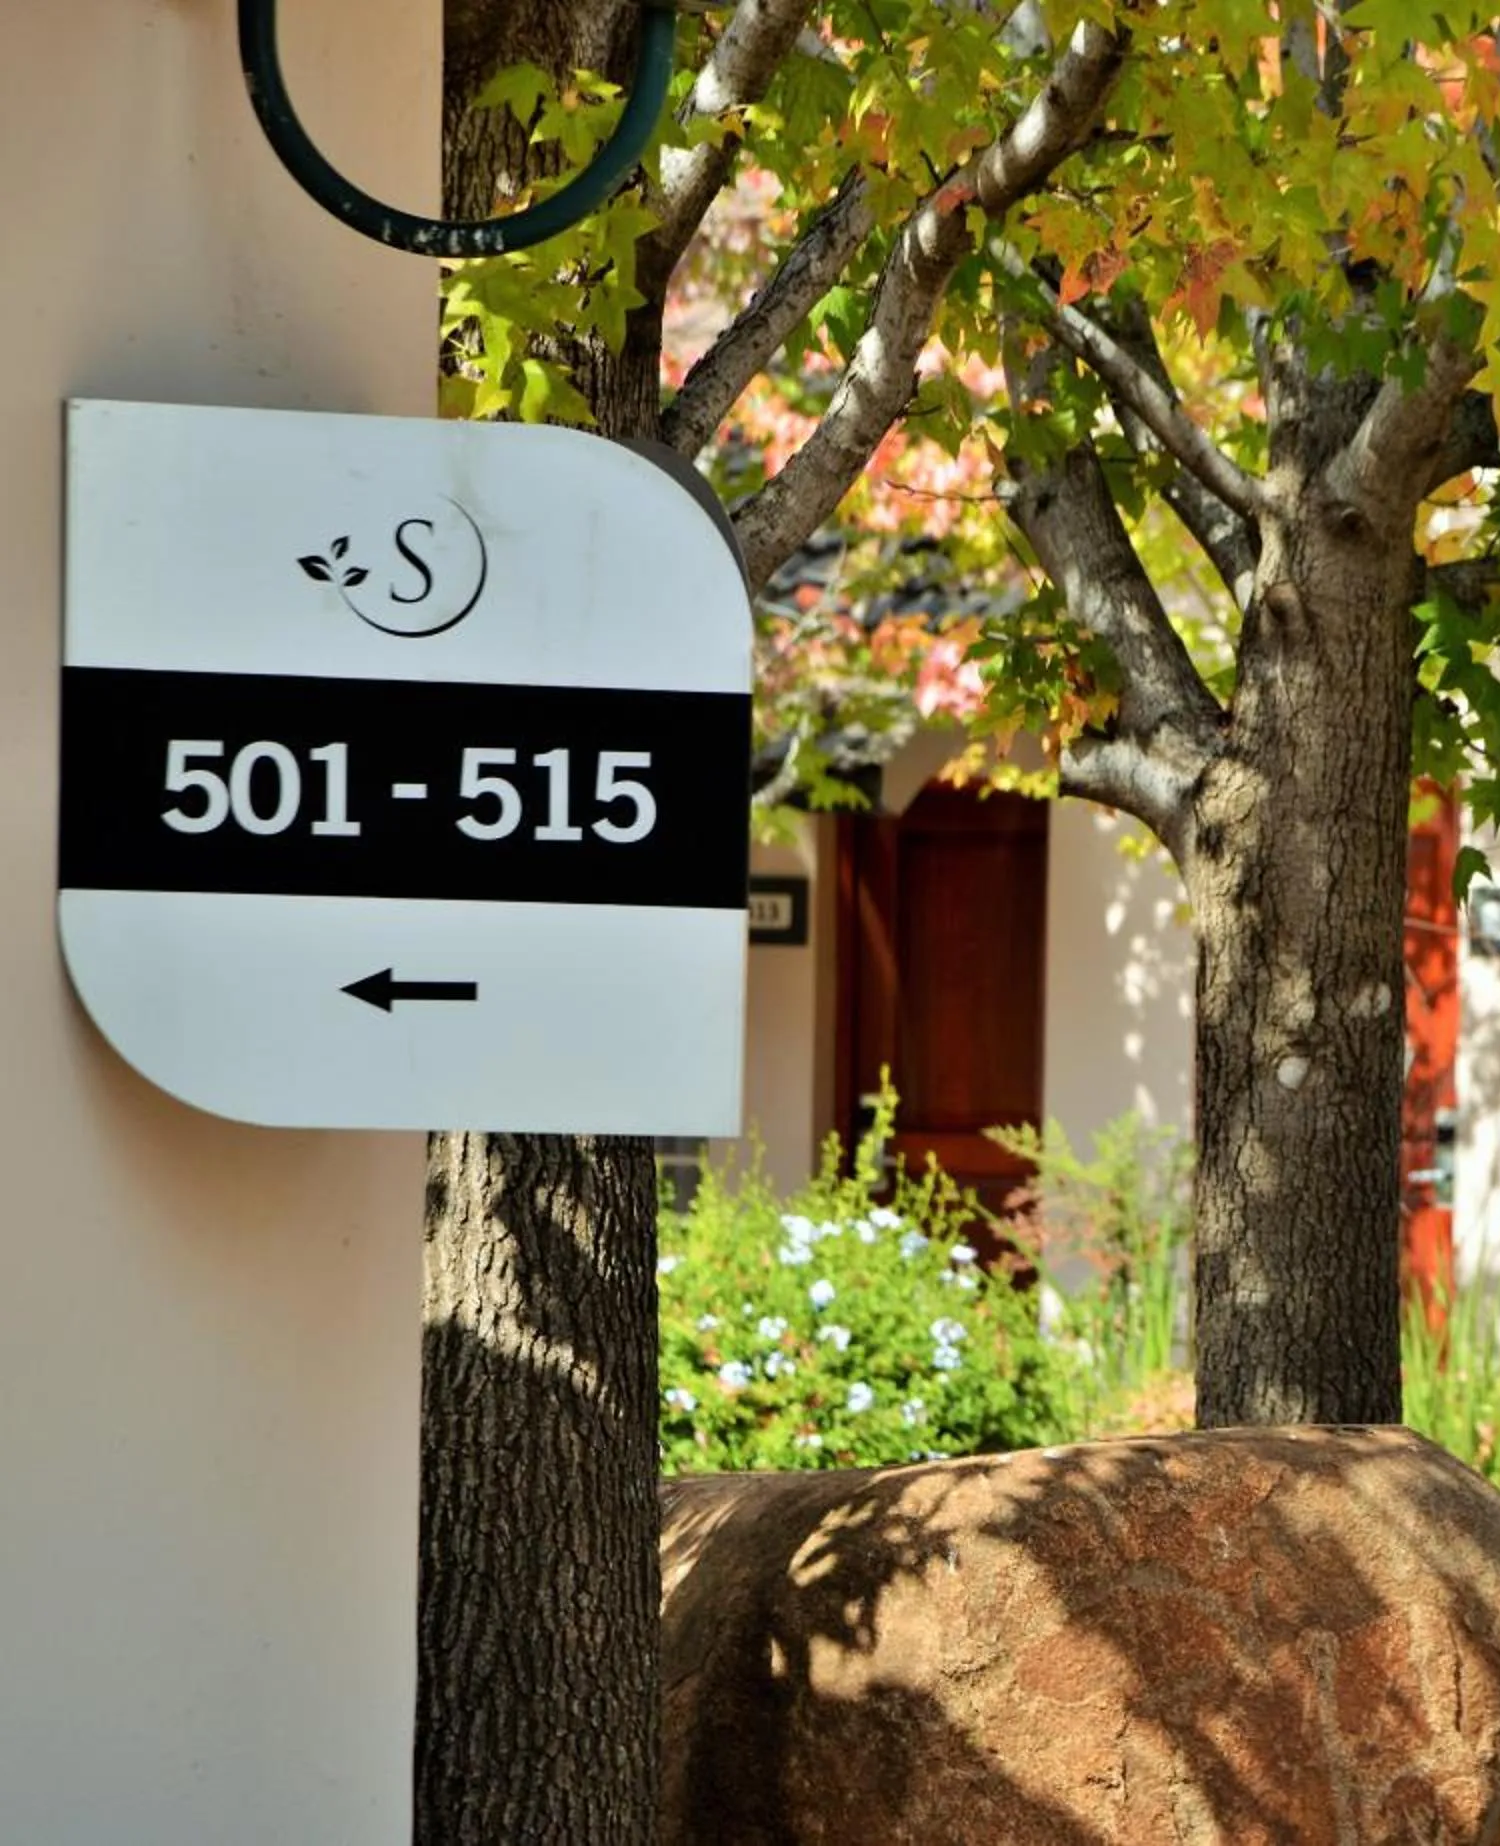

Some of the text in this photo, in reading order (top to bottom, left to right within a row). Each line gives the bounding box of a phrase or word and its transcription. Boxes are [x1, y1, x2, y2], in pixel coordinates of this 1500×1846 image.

[389, 518, 434, 604] S
[161, 739, 657, 843] 501 - 515
